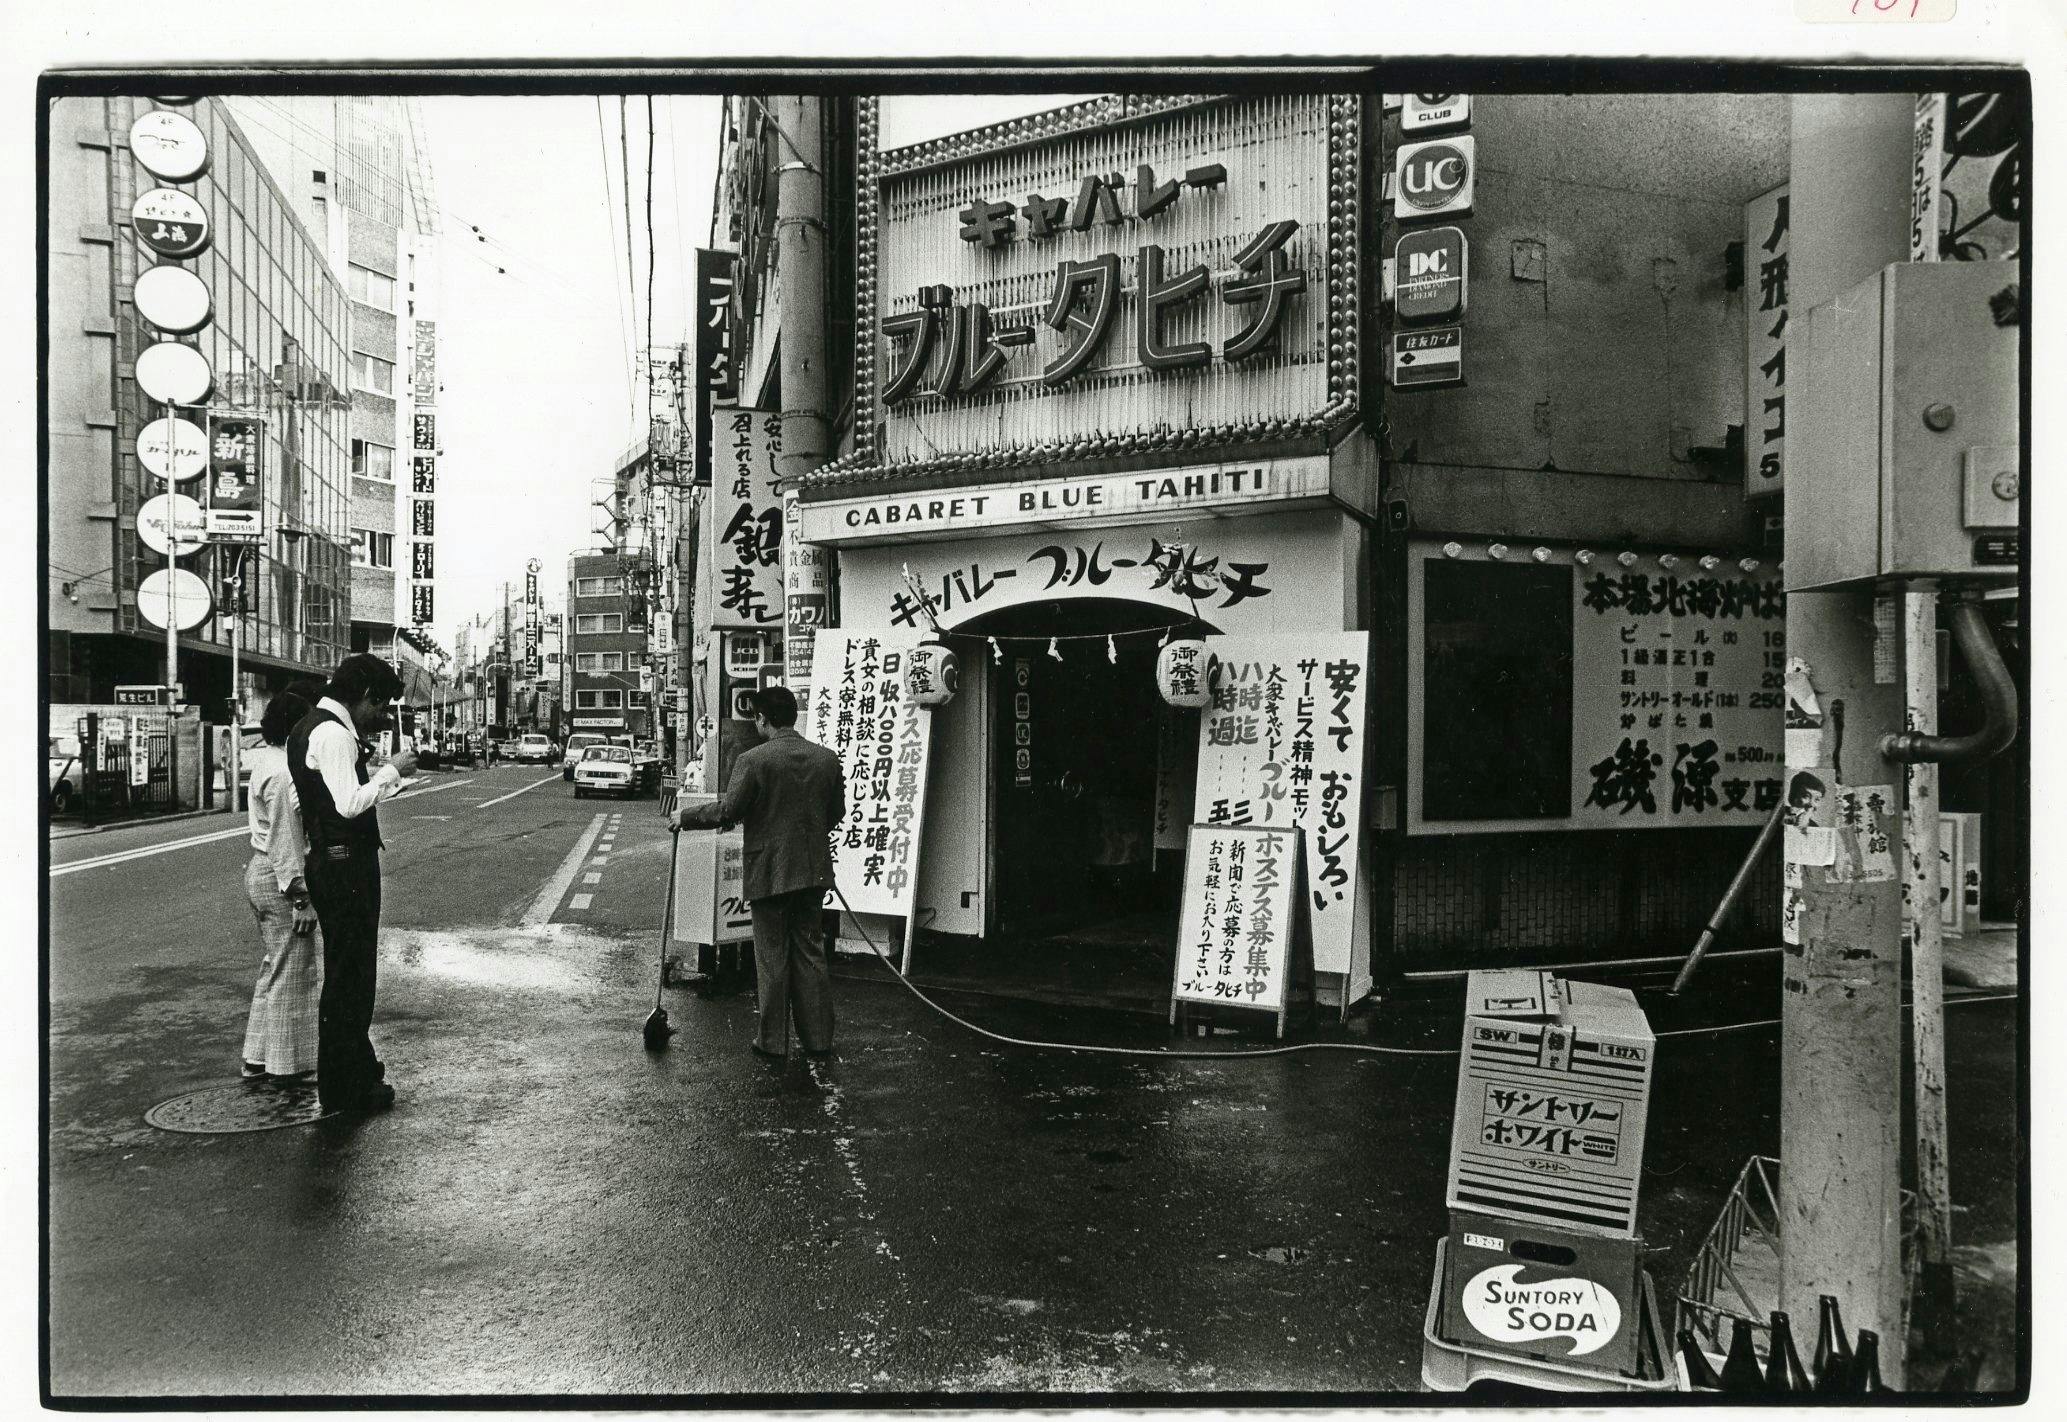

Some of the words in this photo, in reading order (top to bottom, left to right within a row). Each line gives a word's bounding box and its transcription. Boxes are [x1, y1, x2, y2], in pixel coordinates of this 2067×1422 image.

[1418, 109, 1451, 121] CLUB
[959, 163, 1227, 249] キャバレー
[1410, 248, 1448, 276] DC
[882, 219, 1306, 406] ブルータヒチ
[845, 496, 989, 527] CABARET
[1019, 485, 1103, 512] BLUE
[1135, 468, 1263, 500] TAHITI
[890, 559, 1018, 628] キャバレー
[1026, 537, 1273, 610] ブルータヒチ
[1583, 572, 1787, 620] 本場北海炉ば
[788, 605, 825, 625] カワノ
[732, 647, 759, 655] JCB
[1763, 651, 1786, 668] 15
[1324, 658, 1361, 753] 安くて
[1749, 692, 1786, 709] 250
[842, 637, 881, 849] 貴女の相談に応じる店
[1313, 770, 1353, 911] おもしろい
[1195, 838, 1225, 978] お気軽にお入り下さい
[1218, 839, 1247, 976] 新聞で応募の方は
[1241, 833, 1284, 1002] ホステス募集中
[1181, 979, 1244, 999] ブルータヒチ
[1479, 1029, 1512, 1042] SW
[1489, 1089, 1619, 1125] サントリー
[1484, 1118, 1583, 1155] ホワイト
[1583, 1141, 1616, 1151] WHITE
[1528, 1159, 1567, 1171] サントリー
